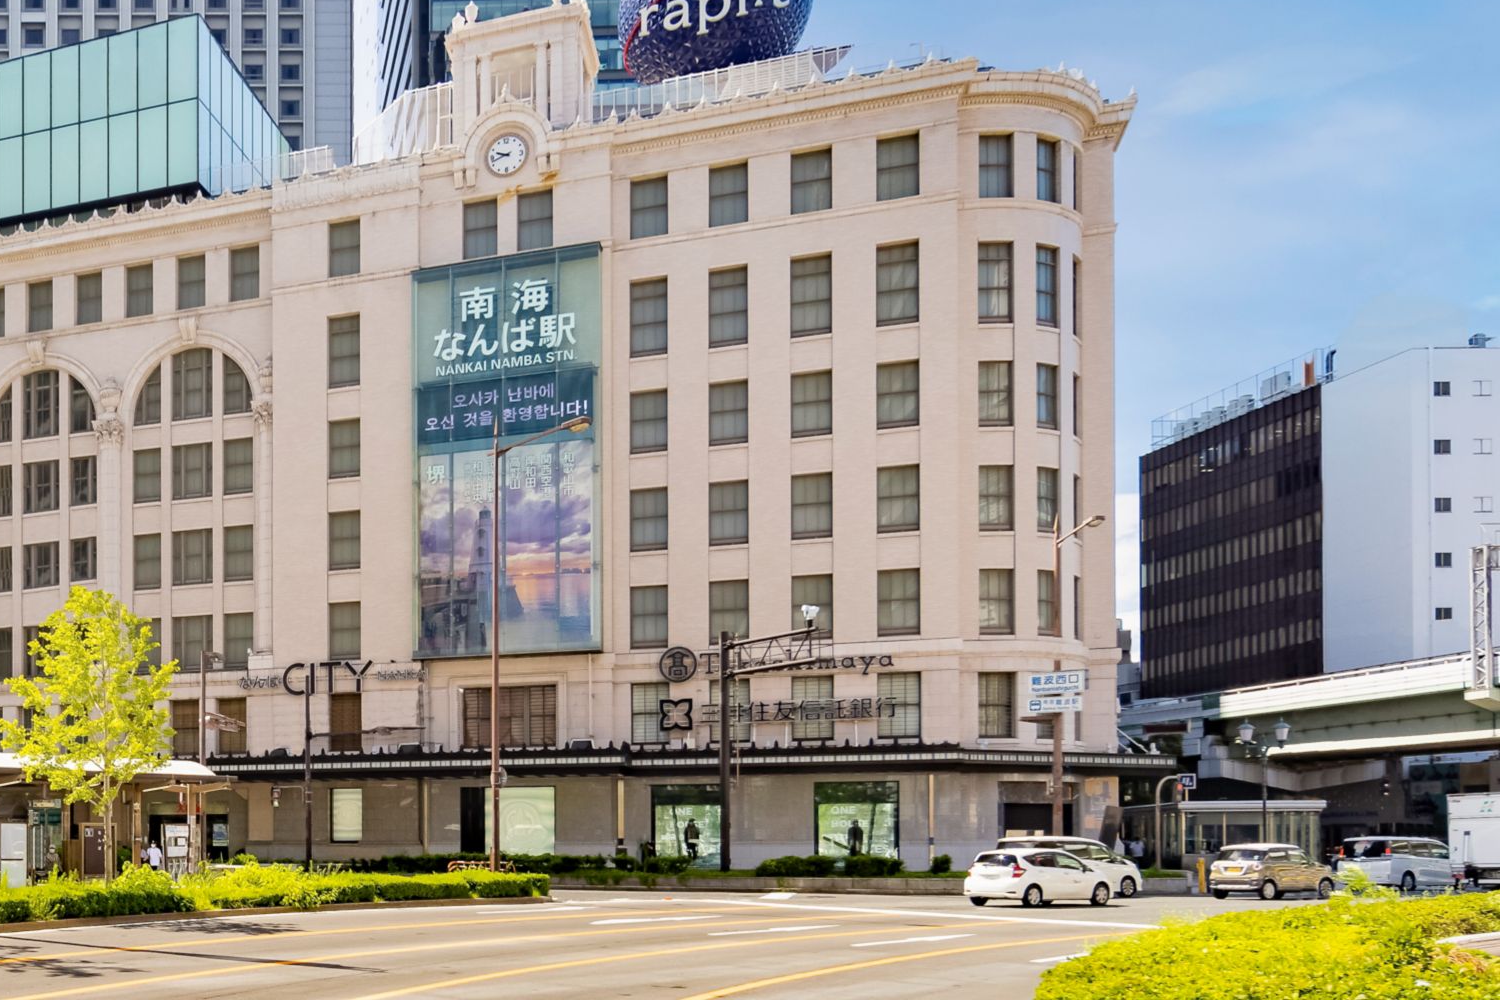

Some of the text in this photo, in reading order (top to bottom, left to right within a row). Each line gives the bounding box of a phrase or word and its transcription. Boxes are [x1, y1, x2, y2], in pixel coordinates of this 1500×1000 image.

[459, 279, 549, 322] 南海
[433, 312, 577, 361] なんば駅
[435, 349, 578, 377] NANKAI NAMBA STN.
[452, 383, 554, 409] 오사카 난바에
[424, 399, 588, 431] 오신 것을 환영합니다!
[283, 660, 373, 696] CITY
[701, 697, 898, 723] 三井住友信託銀行
